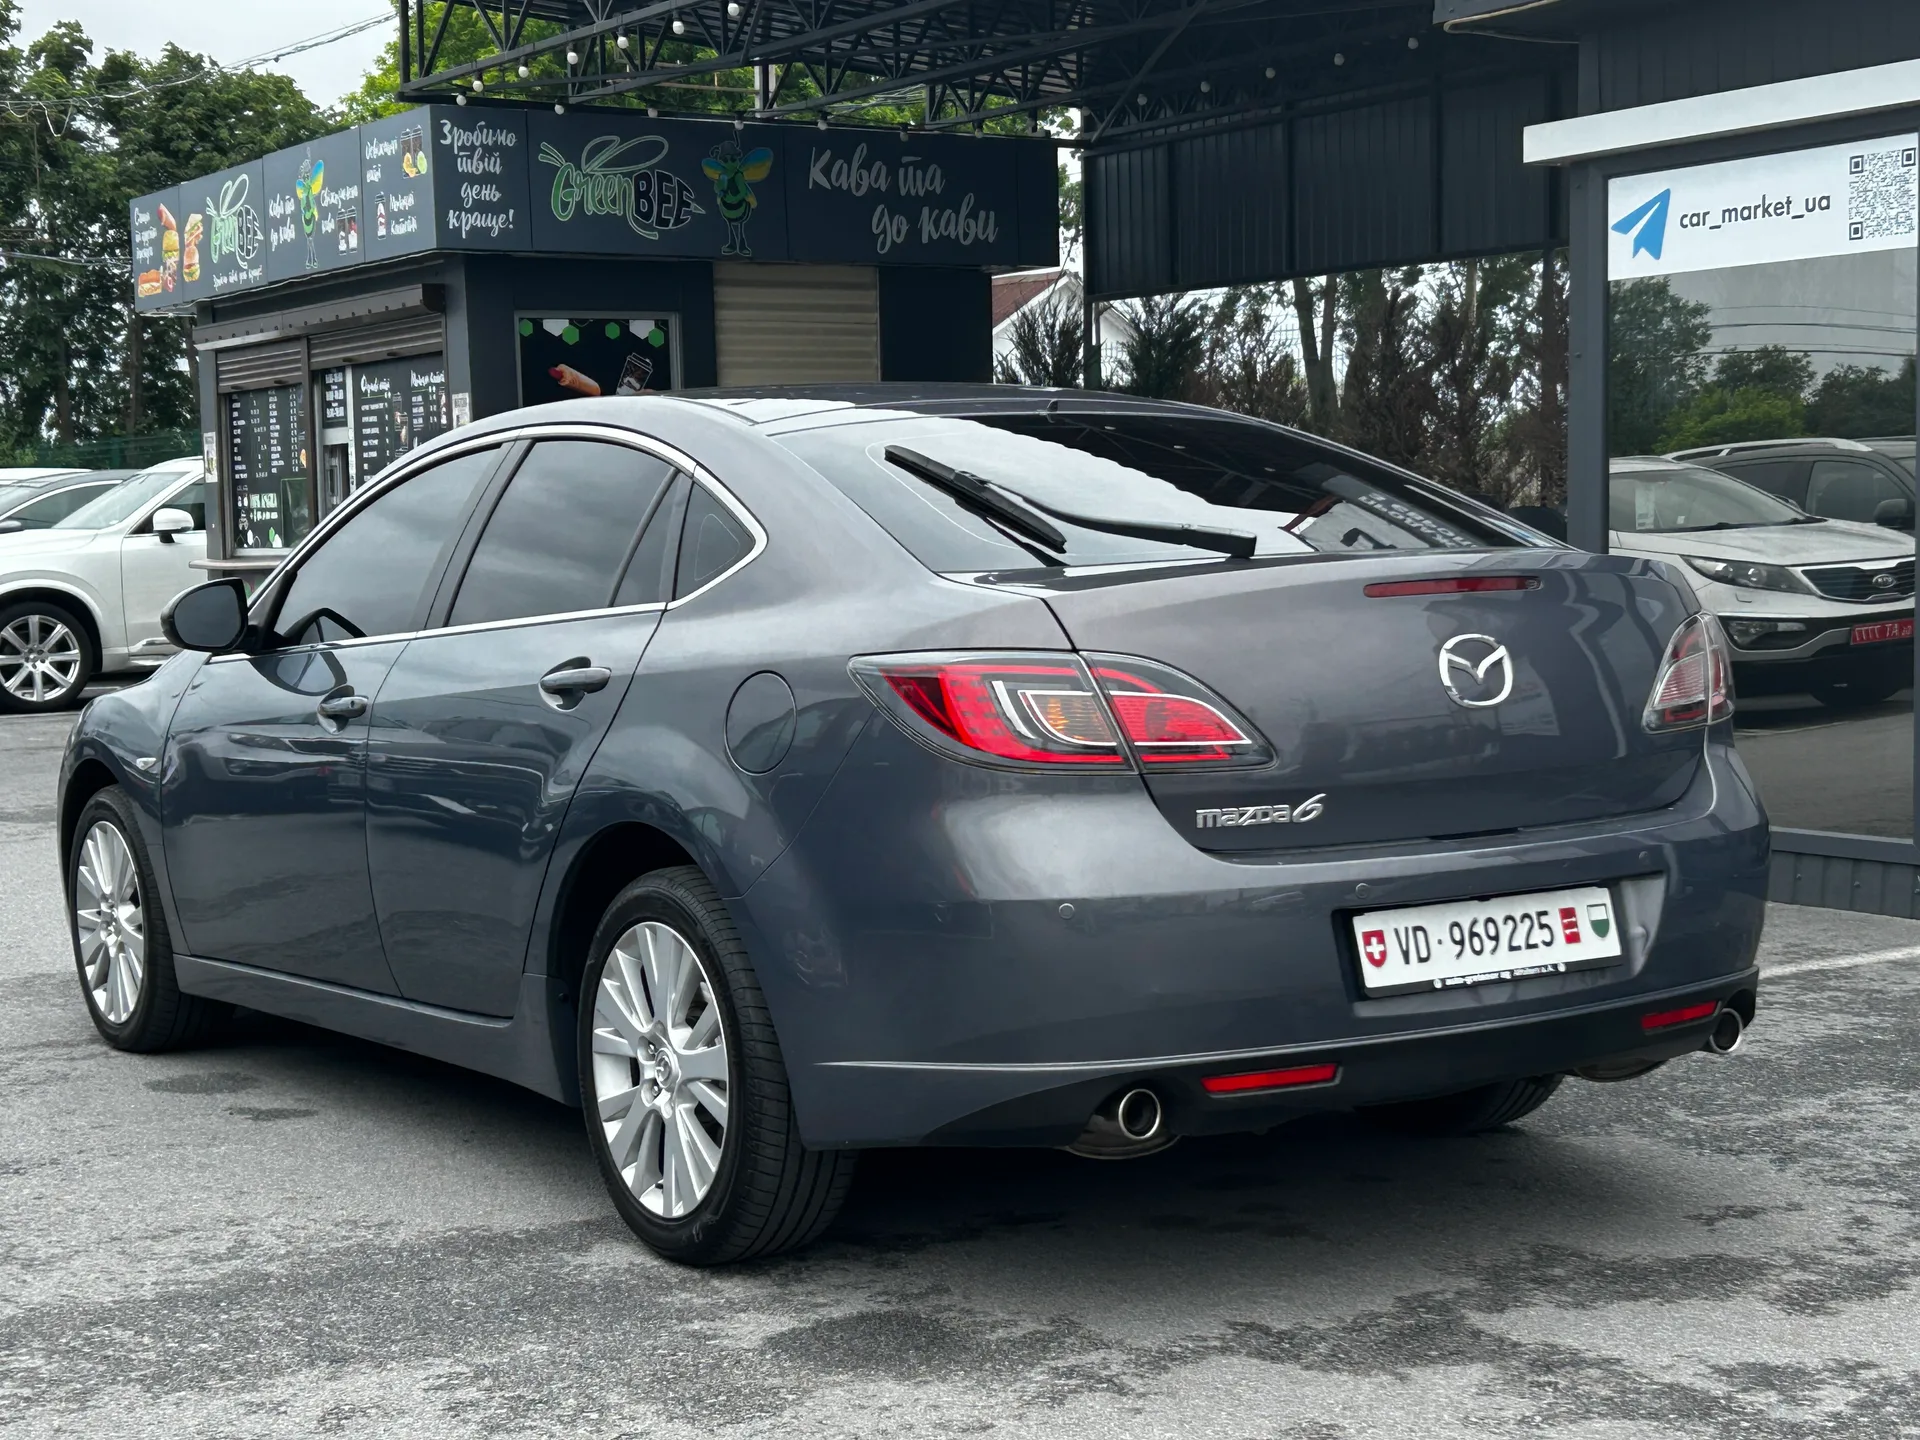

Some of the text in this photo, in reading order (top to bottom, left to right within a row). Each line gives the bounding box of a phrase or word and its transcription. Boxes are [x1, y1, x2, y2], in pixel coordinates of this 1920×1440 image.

[440, 119, 518, 154] Зробимо
[457, 147, 503, 174] твій
[809, 143, 945, 197] Кава та
[460, 182, 502, 208] день
[1680, 195, 1831, 230] car_market_ua
[446, 209, 514, 238] краще!
[872, 193, 998, 254] до кави
[1394, 925, 1431, 965] VD
[1449, 910, 1554, 960] 969225
